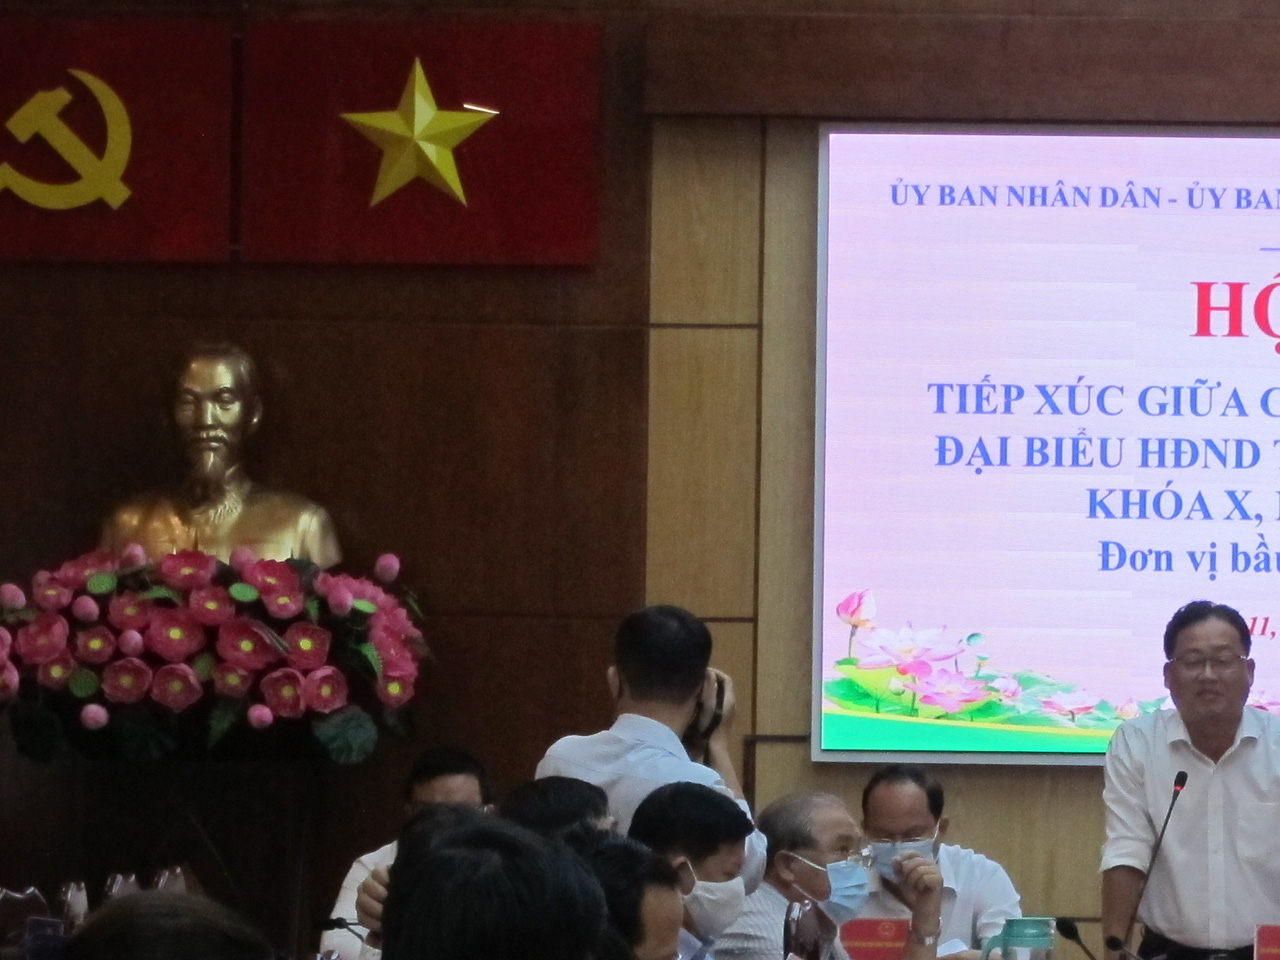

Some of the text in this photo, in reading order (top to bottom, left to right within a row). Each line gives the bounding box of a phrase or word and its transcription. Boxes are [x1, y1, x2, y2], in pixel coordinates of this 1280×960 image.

[890, 178, 931, 206] ỦY
[938, 185, 998, 206] BAN
[1006, 180, 1091, 207] NHÂN
[1099, 181, 1162, 208] DÂN
[1187, 181, 1228, 209] ỦY
[927, 374, 1025, 416] TIẾP
[1034, 375, 1124, 417] XÚC
[1138, 379, 1249, 417] GIỮA
[935, 434, 1010, 475] ĐẠI
[1023, 428, 1125, 469] BIỂU
[1138, 437, 1261, 470] HĐND
[1086, 480, 1213, 520] KHÓA
[1223, 489, 1264, 527] X,
[1098, 540, 1174, 571] Đơn
[1186, 542, 1217, 581] vị
[1249, 616, 1276, 640] 11,
